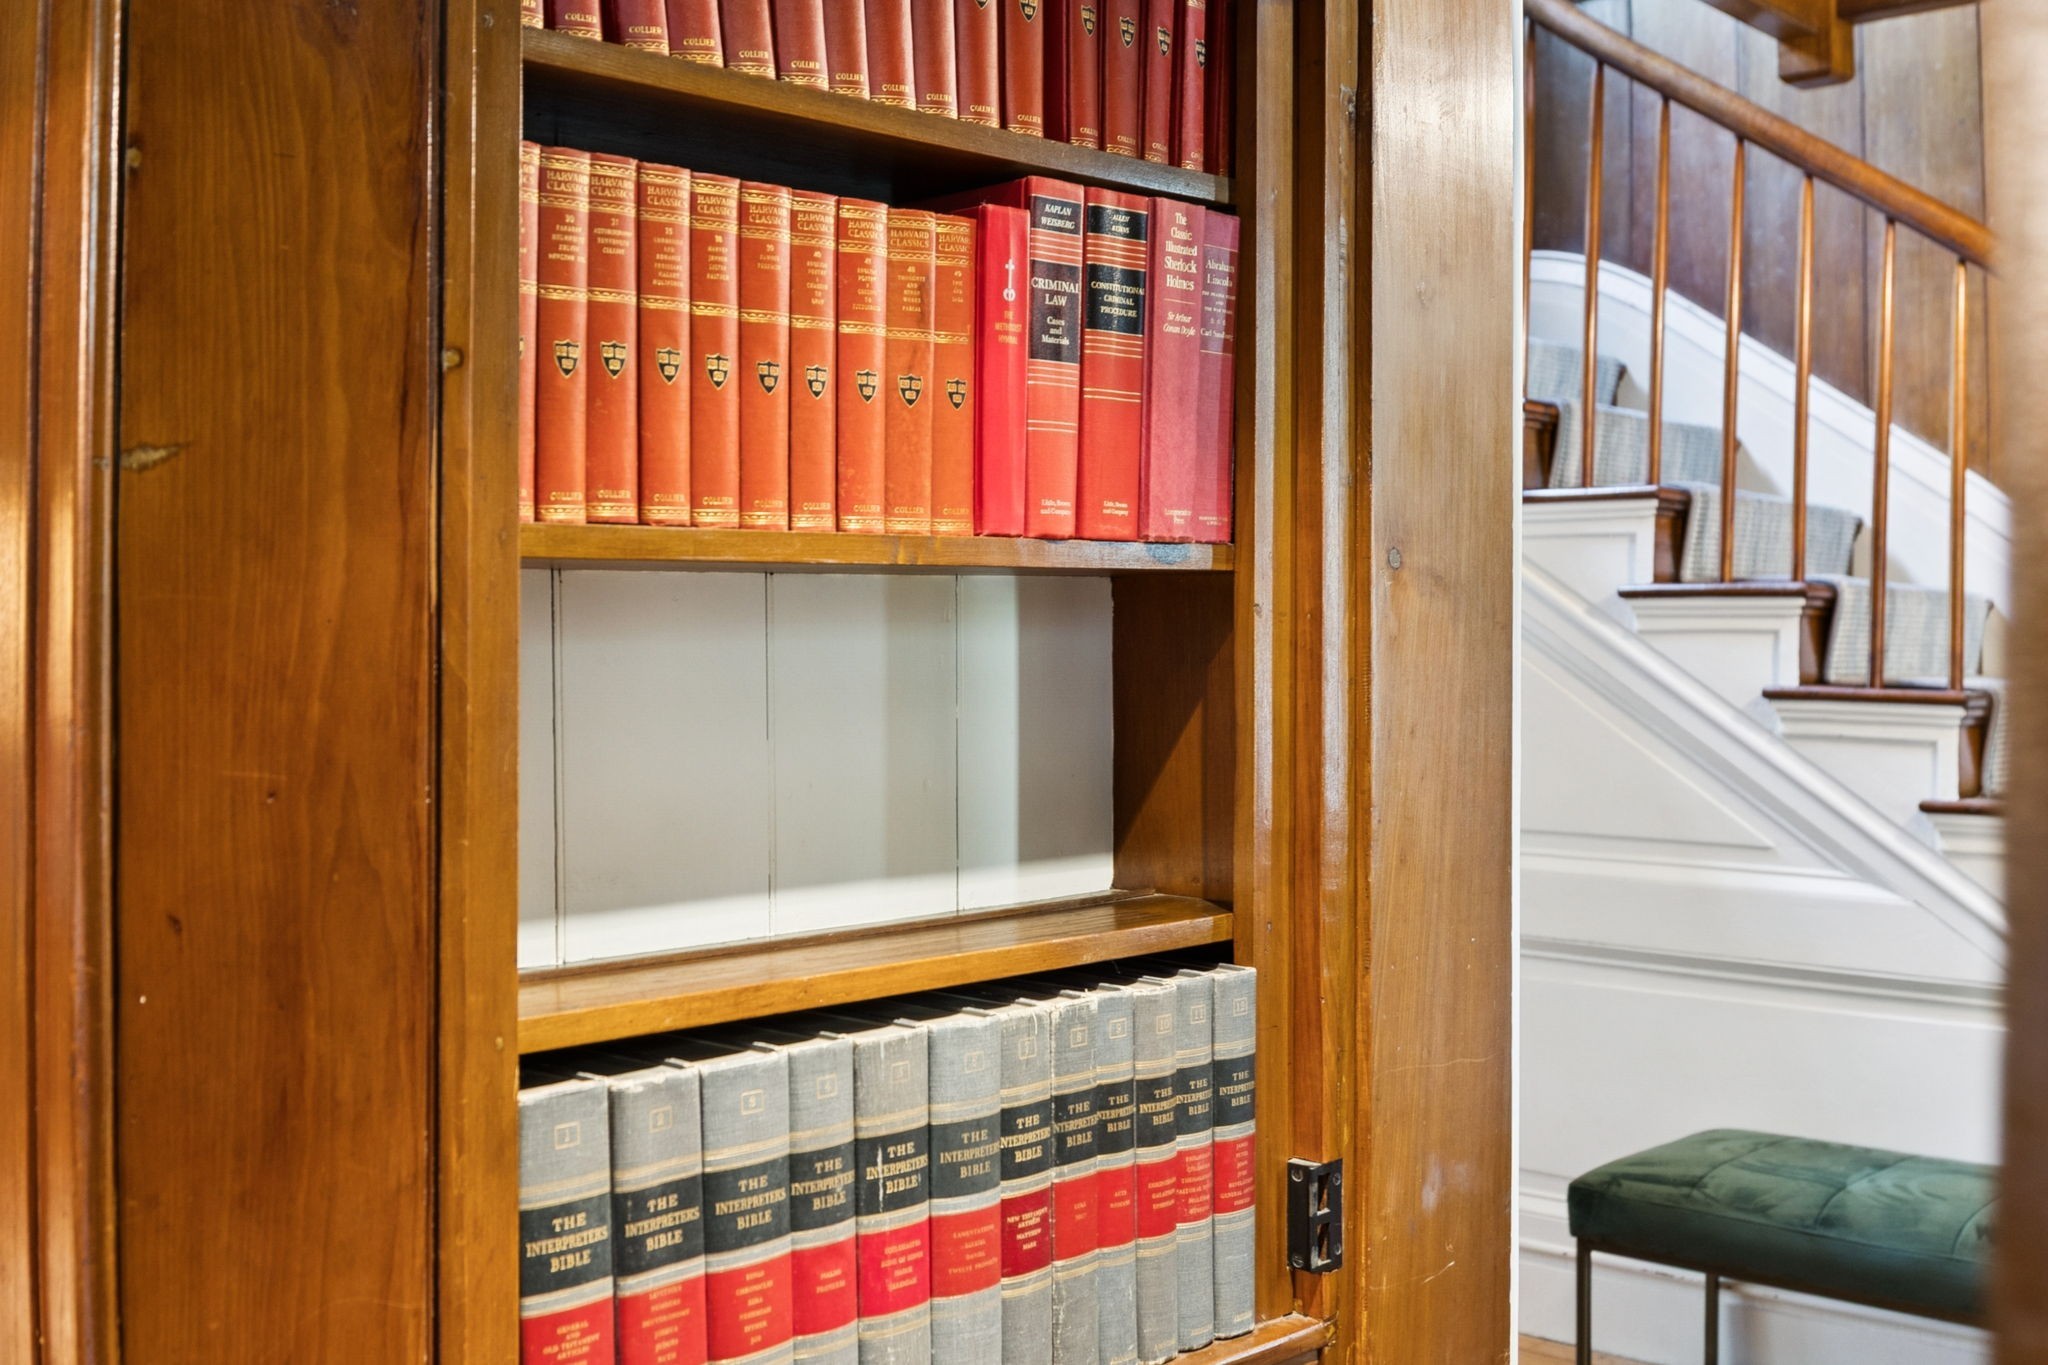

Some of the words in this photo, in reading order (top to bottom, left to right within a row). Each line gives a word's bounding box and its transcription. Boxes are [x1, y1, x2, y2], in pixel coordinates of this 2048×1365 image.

[565, 13, 597, 23] COLLIER
[629, 26, 663, 34] COLLIER
[683, 38, 715, 47] COLLIER
[739, 50, 769, 59] COLLIER
[791, 60, 820, 70] COLLIER
[836, 73, 864, 81] COLLIER
[882, 84, 909, 92] COLLIER
[926, 94, 952, 102] COLLIER
[970, 103, 995, 114] COLLIER
[1017, 113, 1041, 124] COLLIER
[1045, 204, 1072, 216] KAPLAN
[1041, 217, 1075, 229] WEISBERG
[1175, 213, 1187, 225] The
[891, 230, 929, 239] HARVARD
[1171, 227, 1192, 240] Classic
[890, 238, 929, 247] CLASSICS
[1166, 241, 1197, 256] Illustrated
[1164, 256, 1197, 273] Sherlock
[1206, 259, 1234, 272] Abraham
[1166, 275, 1194, 291] Holmes
[1207, 275, 1232, 287] Lincoln
[1045, 294, 1067, 306] LAW
[1104, 295, 1134, 306] CRIMINAL
[1100, 306, 1138, 317] PROCEDURE
[1047, 316, 1065, 326] Cases
[1050, 326, 1062, 334] and
[1200, 328, 1212, 336] Carl
[1042, 334, 1069, 345] Materials
[550, 492, 583, 501] COLLIER
[597, 489, 631, 499] COLLIER
[654, 493, 684, 502] COLLIER
[703, 496, 733, 505] COLLIER
[803, 502, 832, 510] COLLIER
[853, 504, 880, 513] COLLIER
[895, 506, 924, 514] COLLIER
[1232, 1070, 1249, 1081] THE
[1189, 1078, 1208, 1090] THE
[1154, 1087, 1173, 1098] THE
[1108, 1094, 1129, 1105] THE
[1231, 1094, 1251, 1107] BIBLE
[1068, 1101, 1090, 1115] THE
[1189, 1102, 1209, 1116] BIBLE
[1016, 1114, 1040, 1129] THE
[1153, 1111, 1174, 1126] BIBLE
[1107, 1119, 1131, 1133] BIBLE
[961, 1130, 988, 1144] THE
[1067, 1132, 1092, 1147] BIBLE
[887, 1141, 915, 1158] THE
[1015, 1146, 1043, 1163] BIBLE
[815, 1157, 842, 1174] THE
[960, 1162, 991, 1179] BIBLE
[738, 1175, 768, 1192] THE
[886, 1175, 918, 1194] BIBLE
[647, 1194, 678, 1213] THE
[812, 1191, 846, 1210] BIBLE
[552, 1212, 586, 1232] THE
[737, 1210, 772, 1230] BIBLE
[646, 1229, 683, 1252] BIBLE
[550, 1249, 591, 1273] BIBLE
